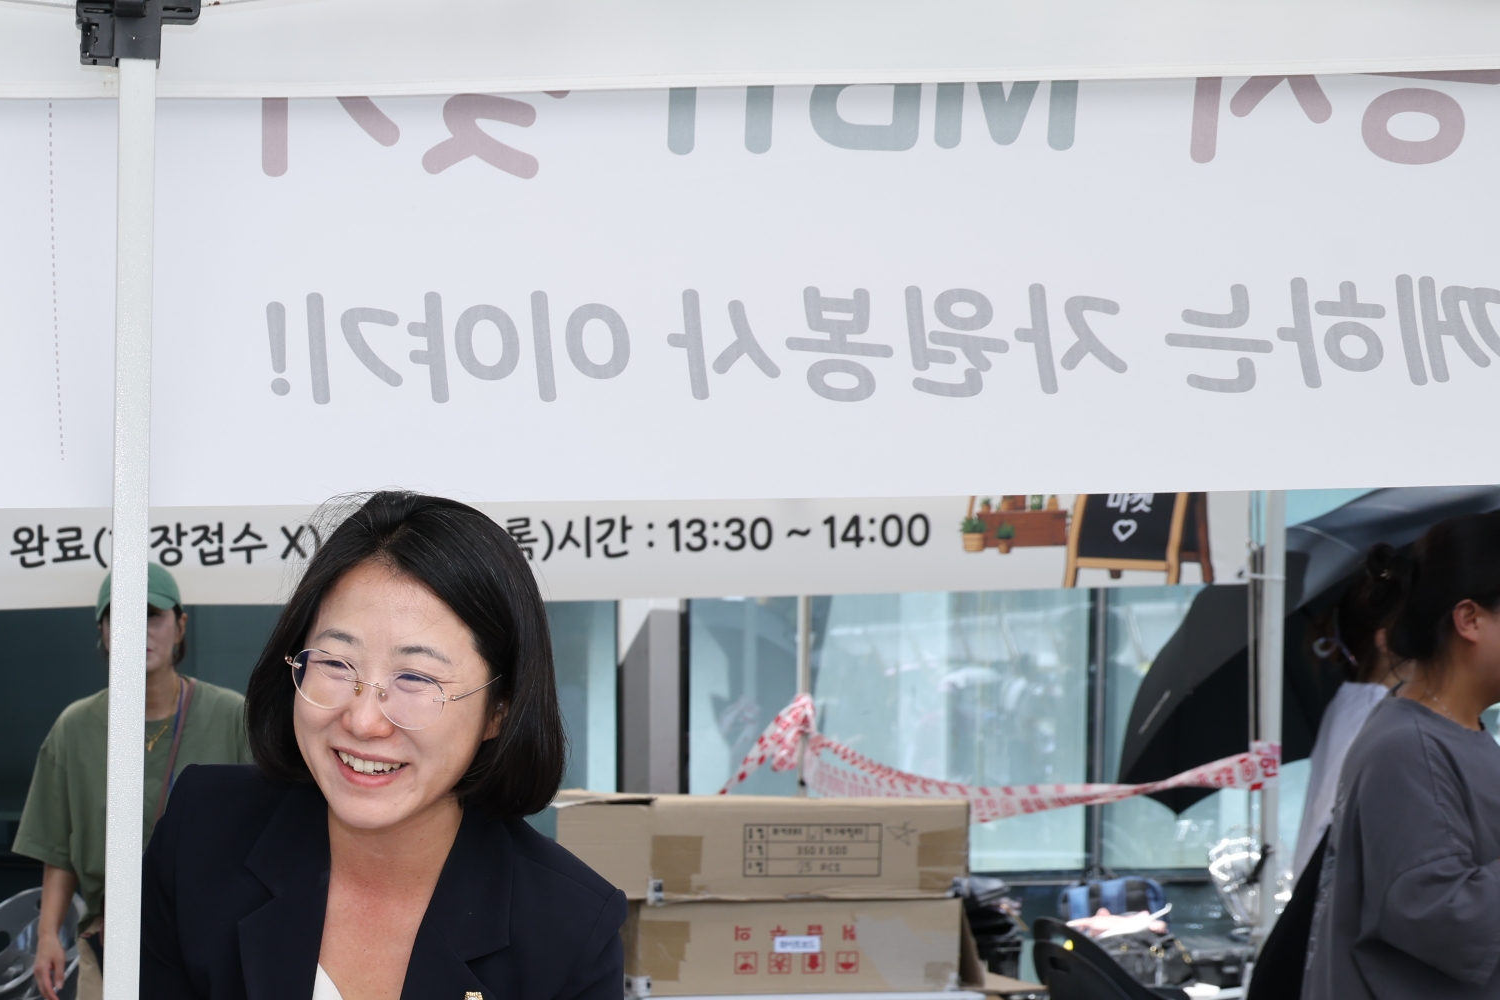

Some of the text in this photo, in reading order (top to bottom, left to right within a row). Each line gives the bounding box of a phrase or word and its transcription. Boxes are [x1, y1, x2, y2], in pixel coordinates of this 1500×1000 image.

[9, 522, 268, 568] 완료(장접수
[667, 516, 773, 553] 13:30
[823, 513, 931, 550] 14:00
